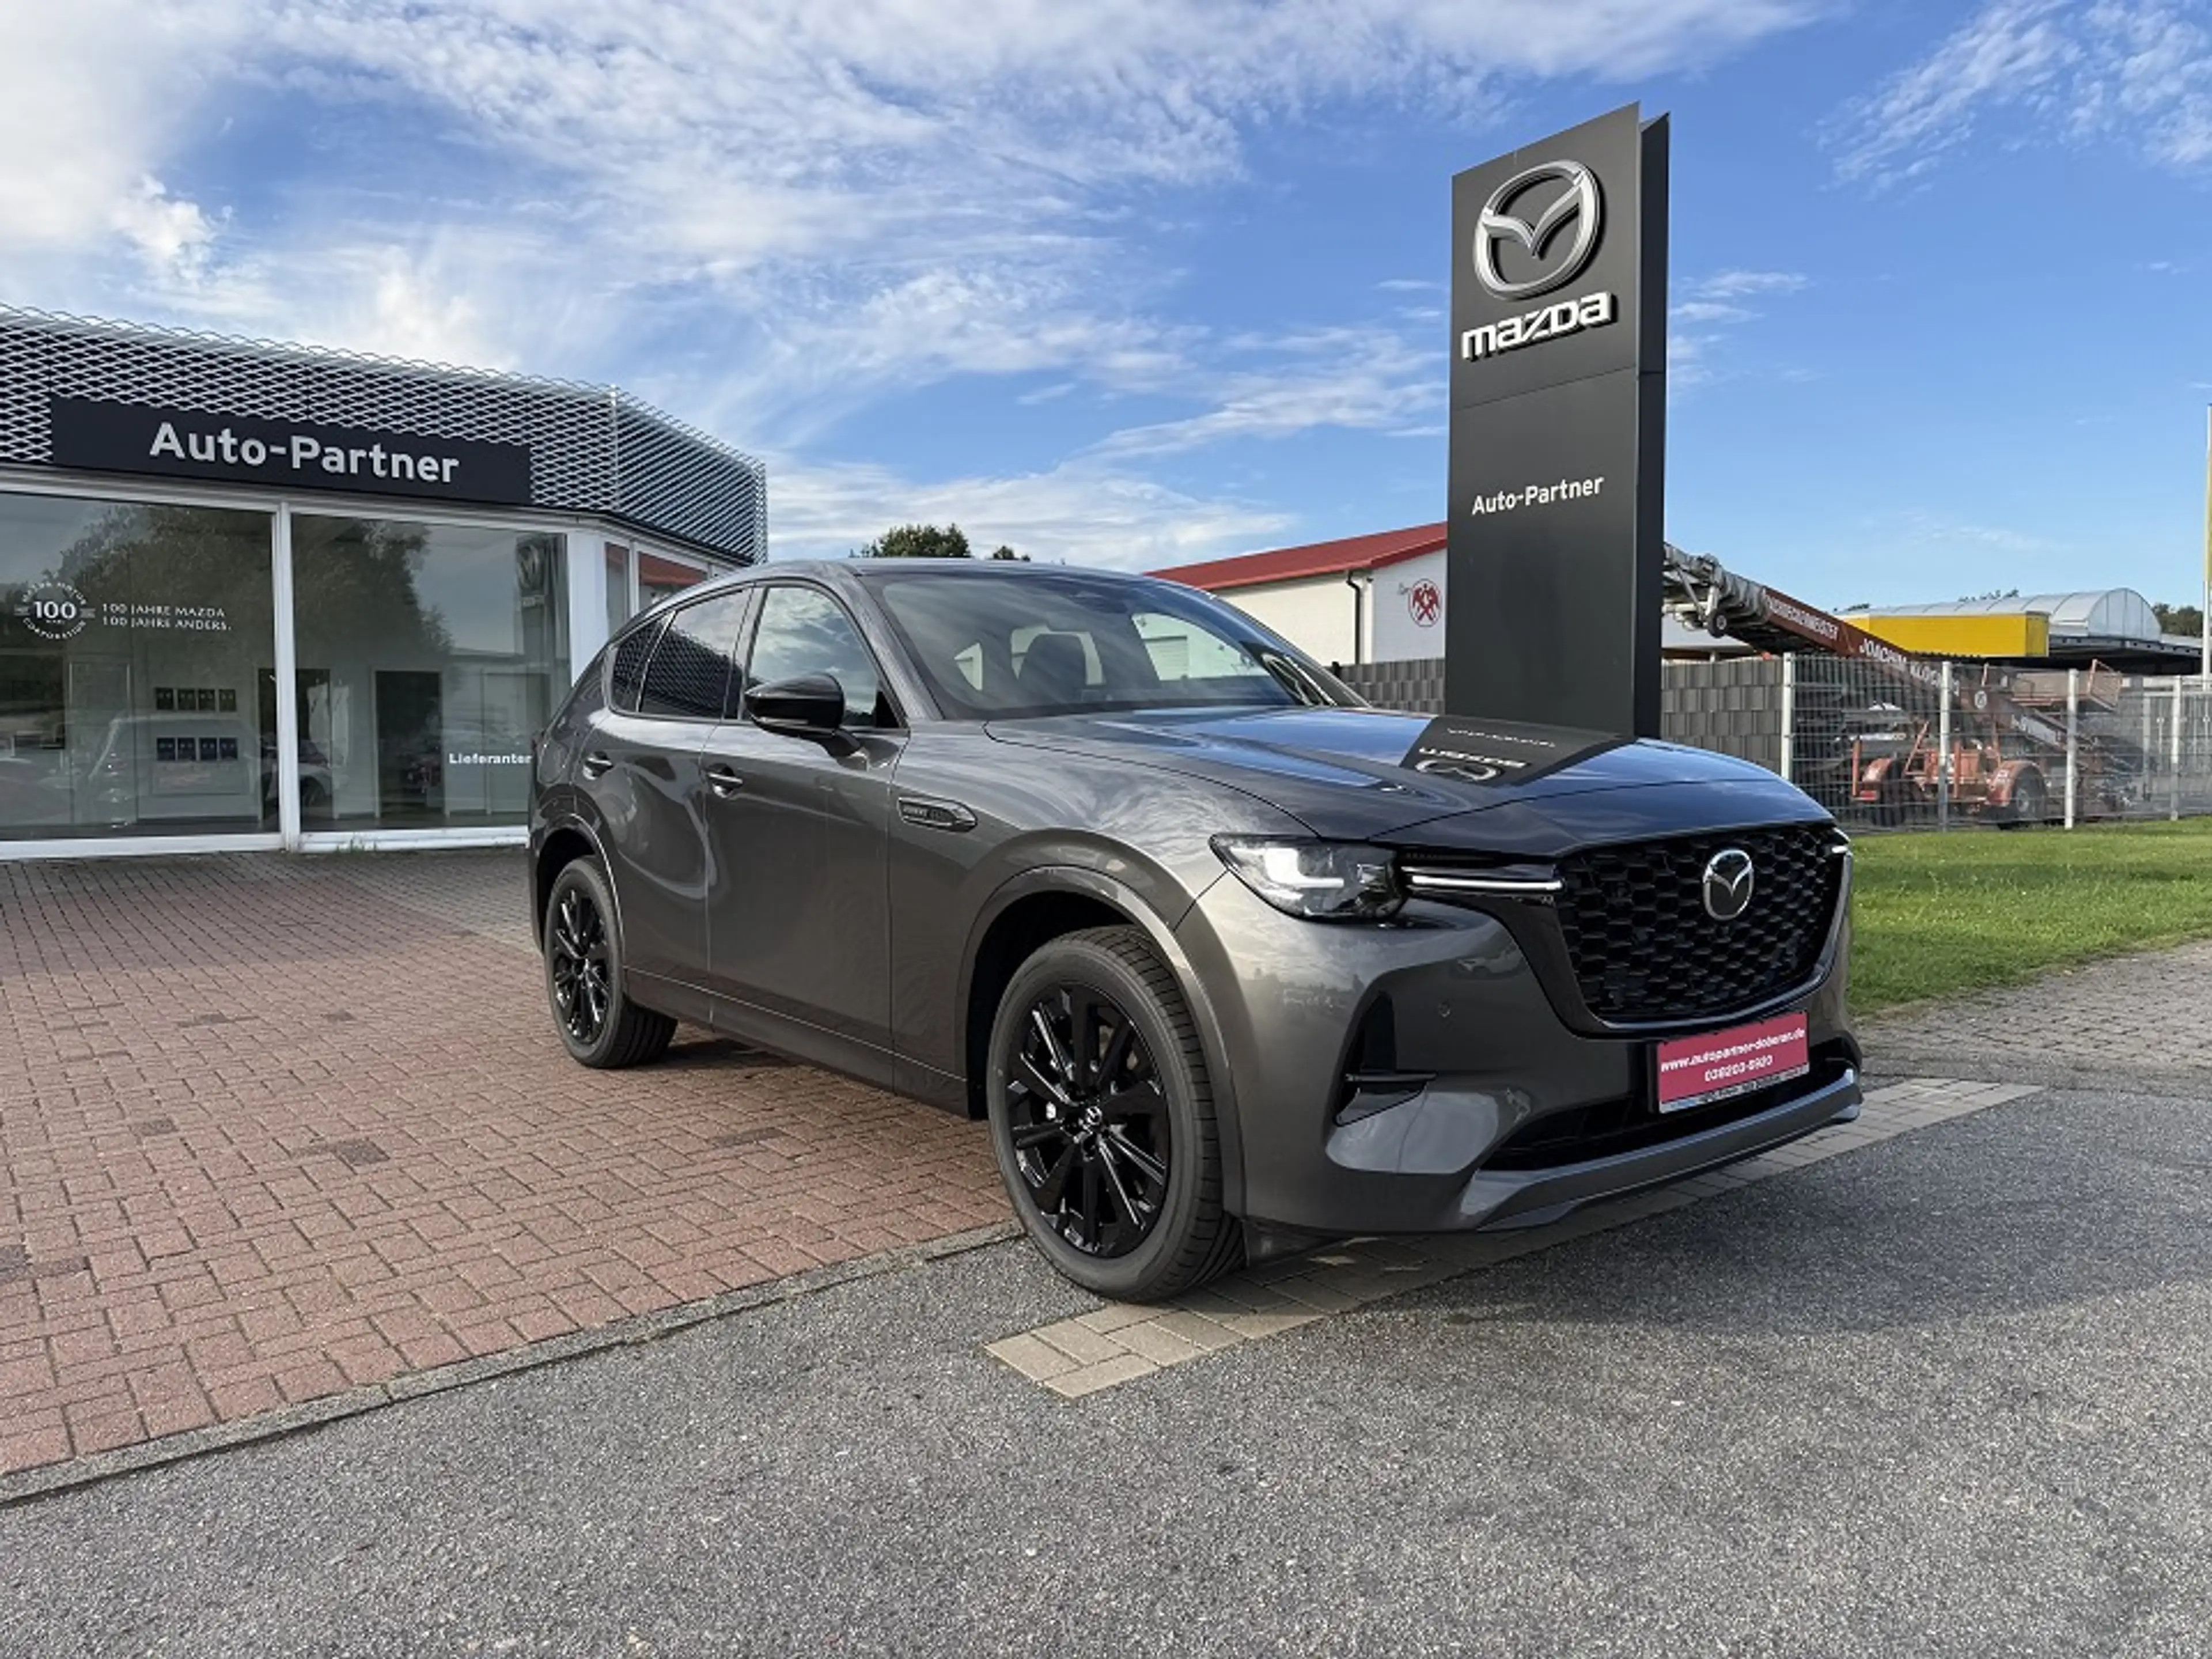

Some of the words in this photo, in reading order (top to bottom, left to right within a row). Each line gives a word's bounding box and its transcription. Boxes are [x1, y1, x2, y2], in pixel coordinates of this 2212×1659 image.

[1461, 291, 1612, 360] mazda
[149, 422, 460, 483] Auto-Partner
[1471, 476, 1604, 515] Auto-Partner
[33, 601, 77, 620] 100
[103, 603, 127, 614] 100
[131, 604, 171, 616] JAHRE
[175, 606, 227, 618] MAZDA
[103, 615, 127, 627] 100
[131, 616, 171, 628] JAHRE
